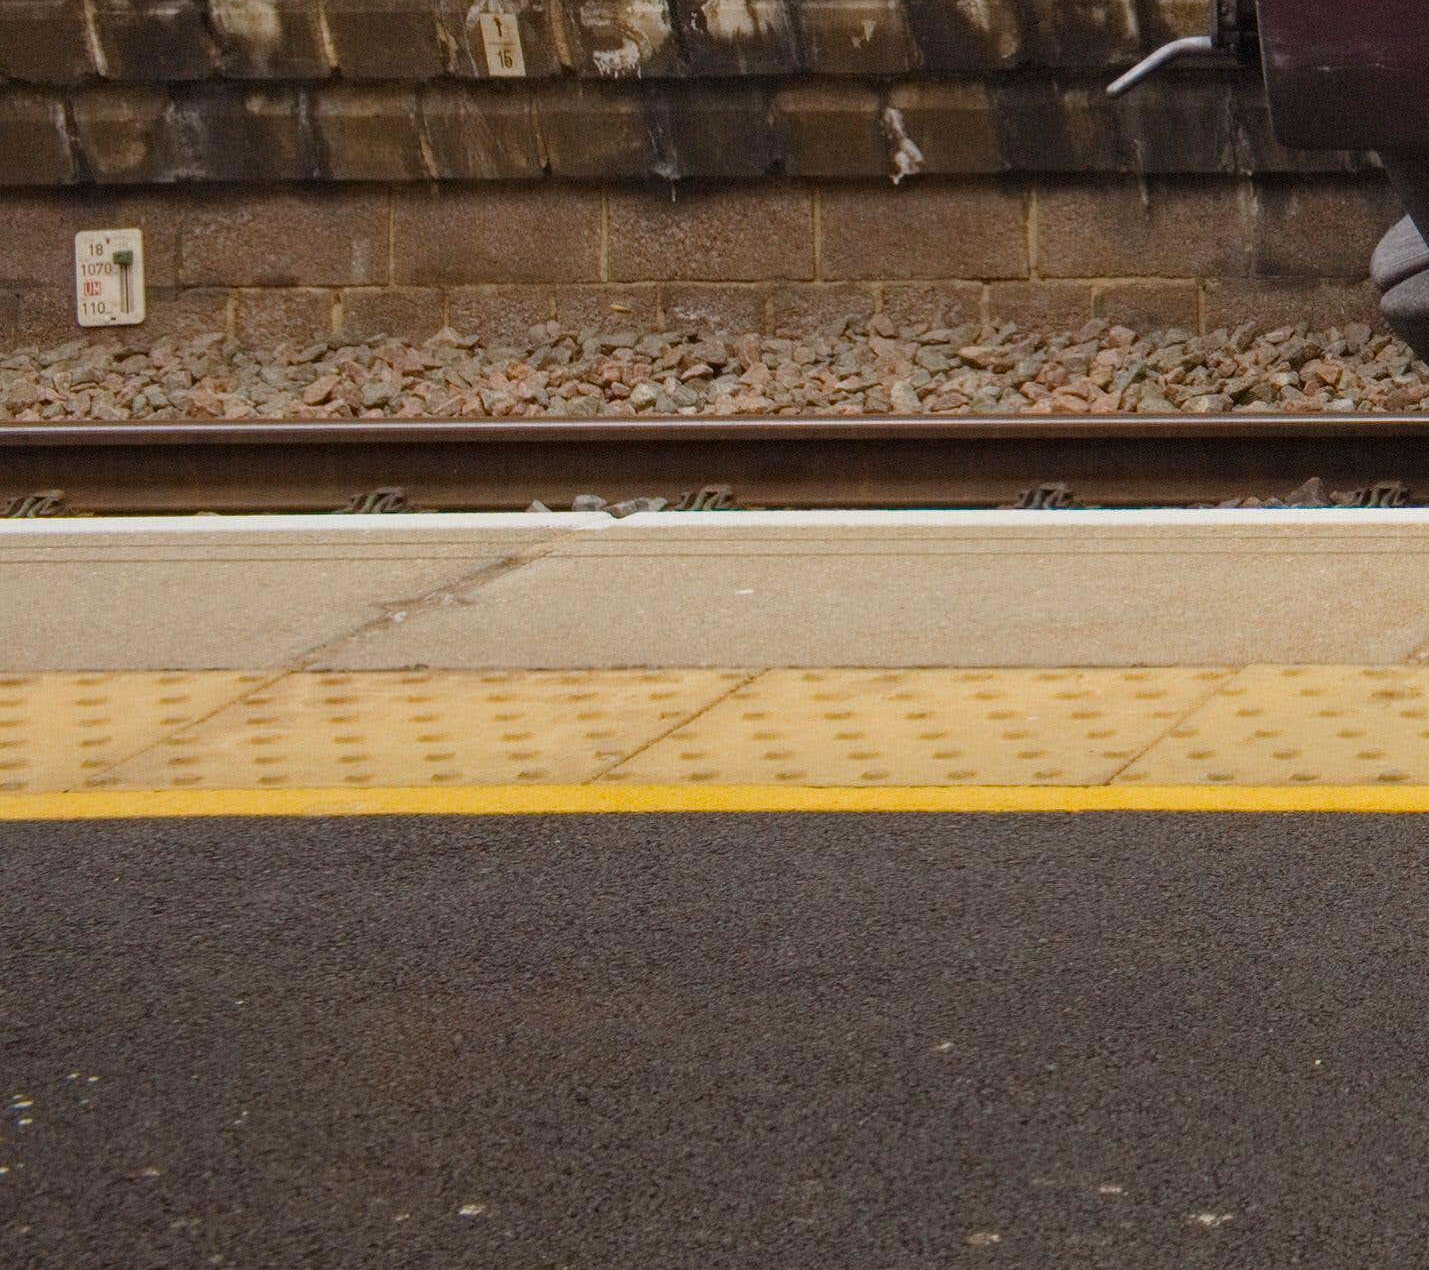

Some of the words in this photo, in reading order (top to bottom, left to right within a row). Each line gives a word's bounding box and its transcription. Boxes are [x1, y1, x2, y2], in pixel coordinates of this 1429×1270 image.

[89, 243, 104, 256] 18
[81, 262, 112, 276] 1070
[82, 302, 106, 315] 110
